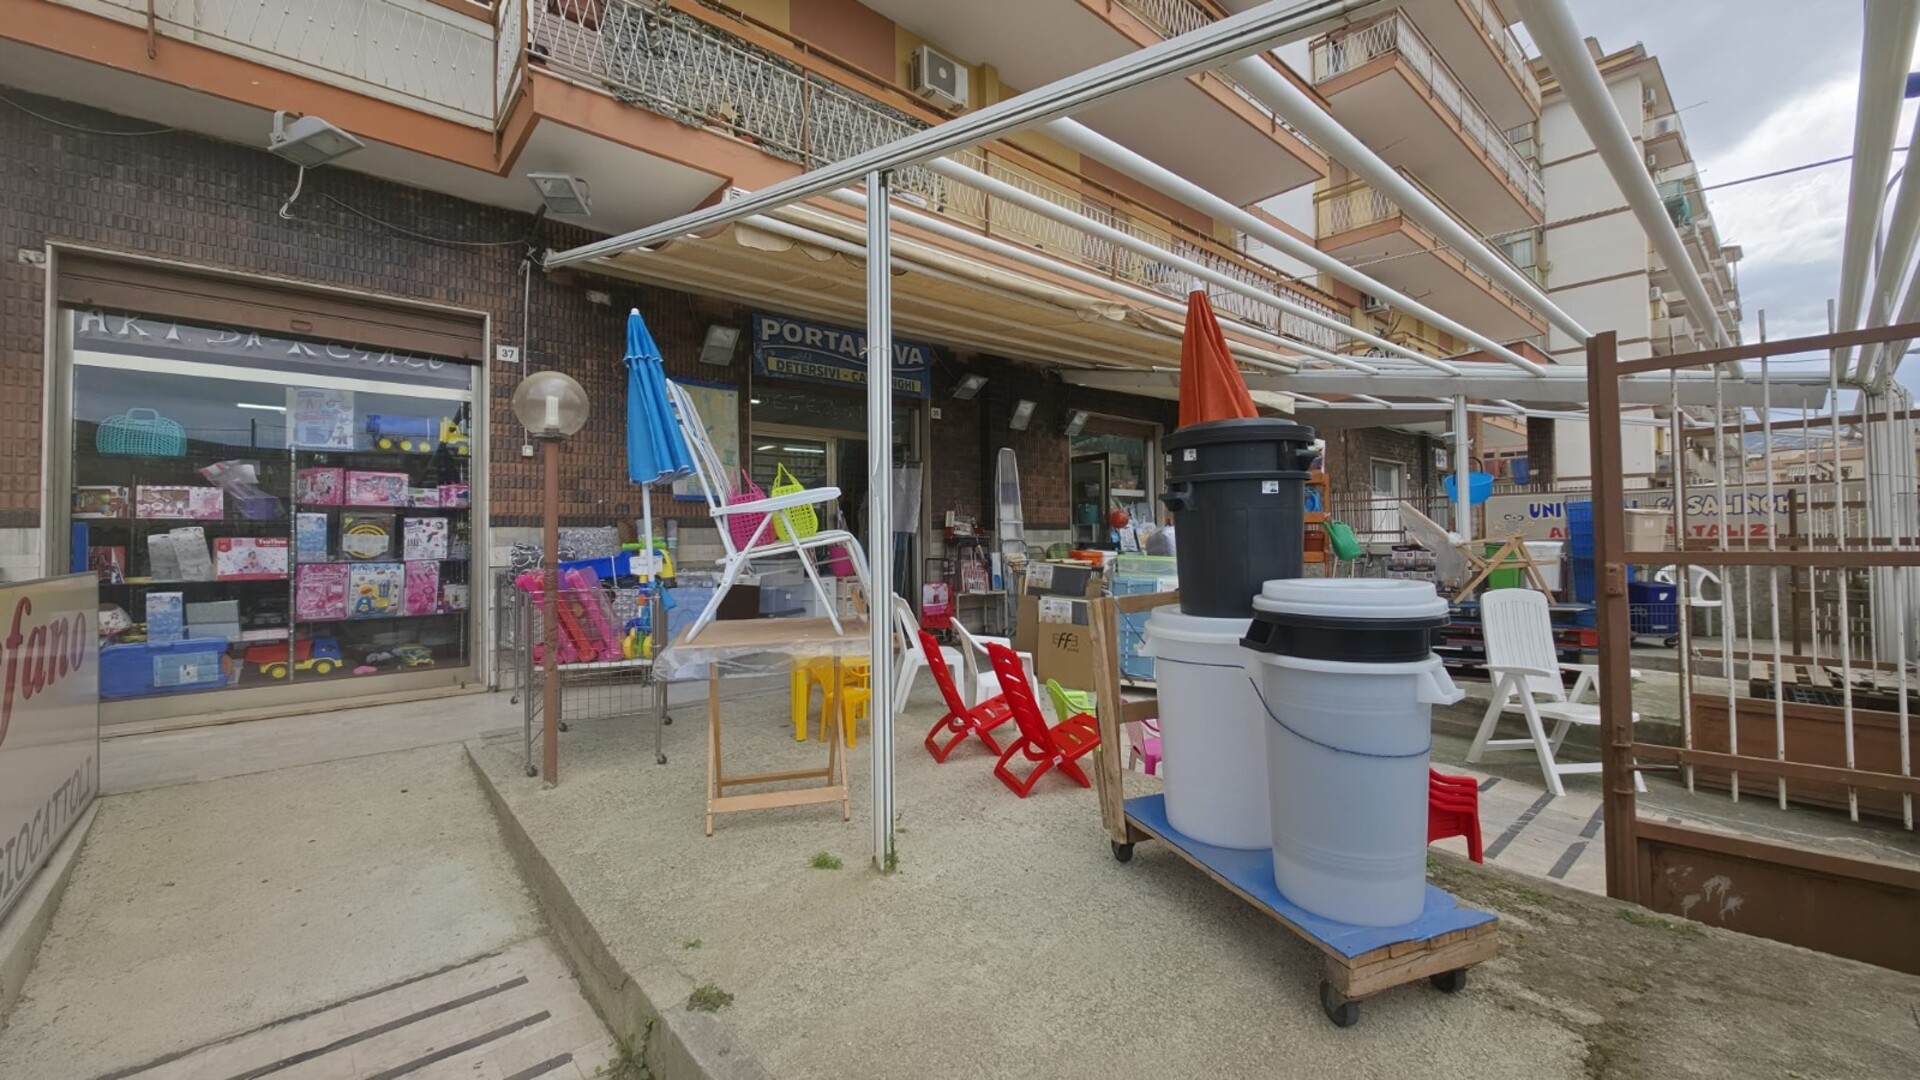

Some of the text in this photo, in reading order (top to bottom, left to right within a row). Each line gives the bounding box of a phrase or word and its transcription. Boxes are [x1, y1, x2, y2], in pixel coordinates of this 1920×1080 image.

[501, 348, 514, 359] 37
[761, 318, 925, 365] PORTAVA
[776, 358, 840, 379] DETERSIVI
[851, 371, 915, 391] CAGHI
[1656, 493, 1807, 516] CSALINGHI
[0, 597, 86, 746] fano
